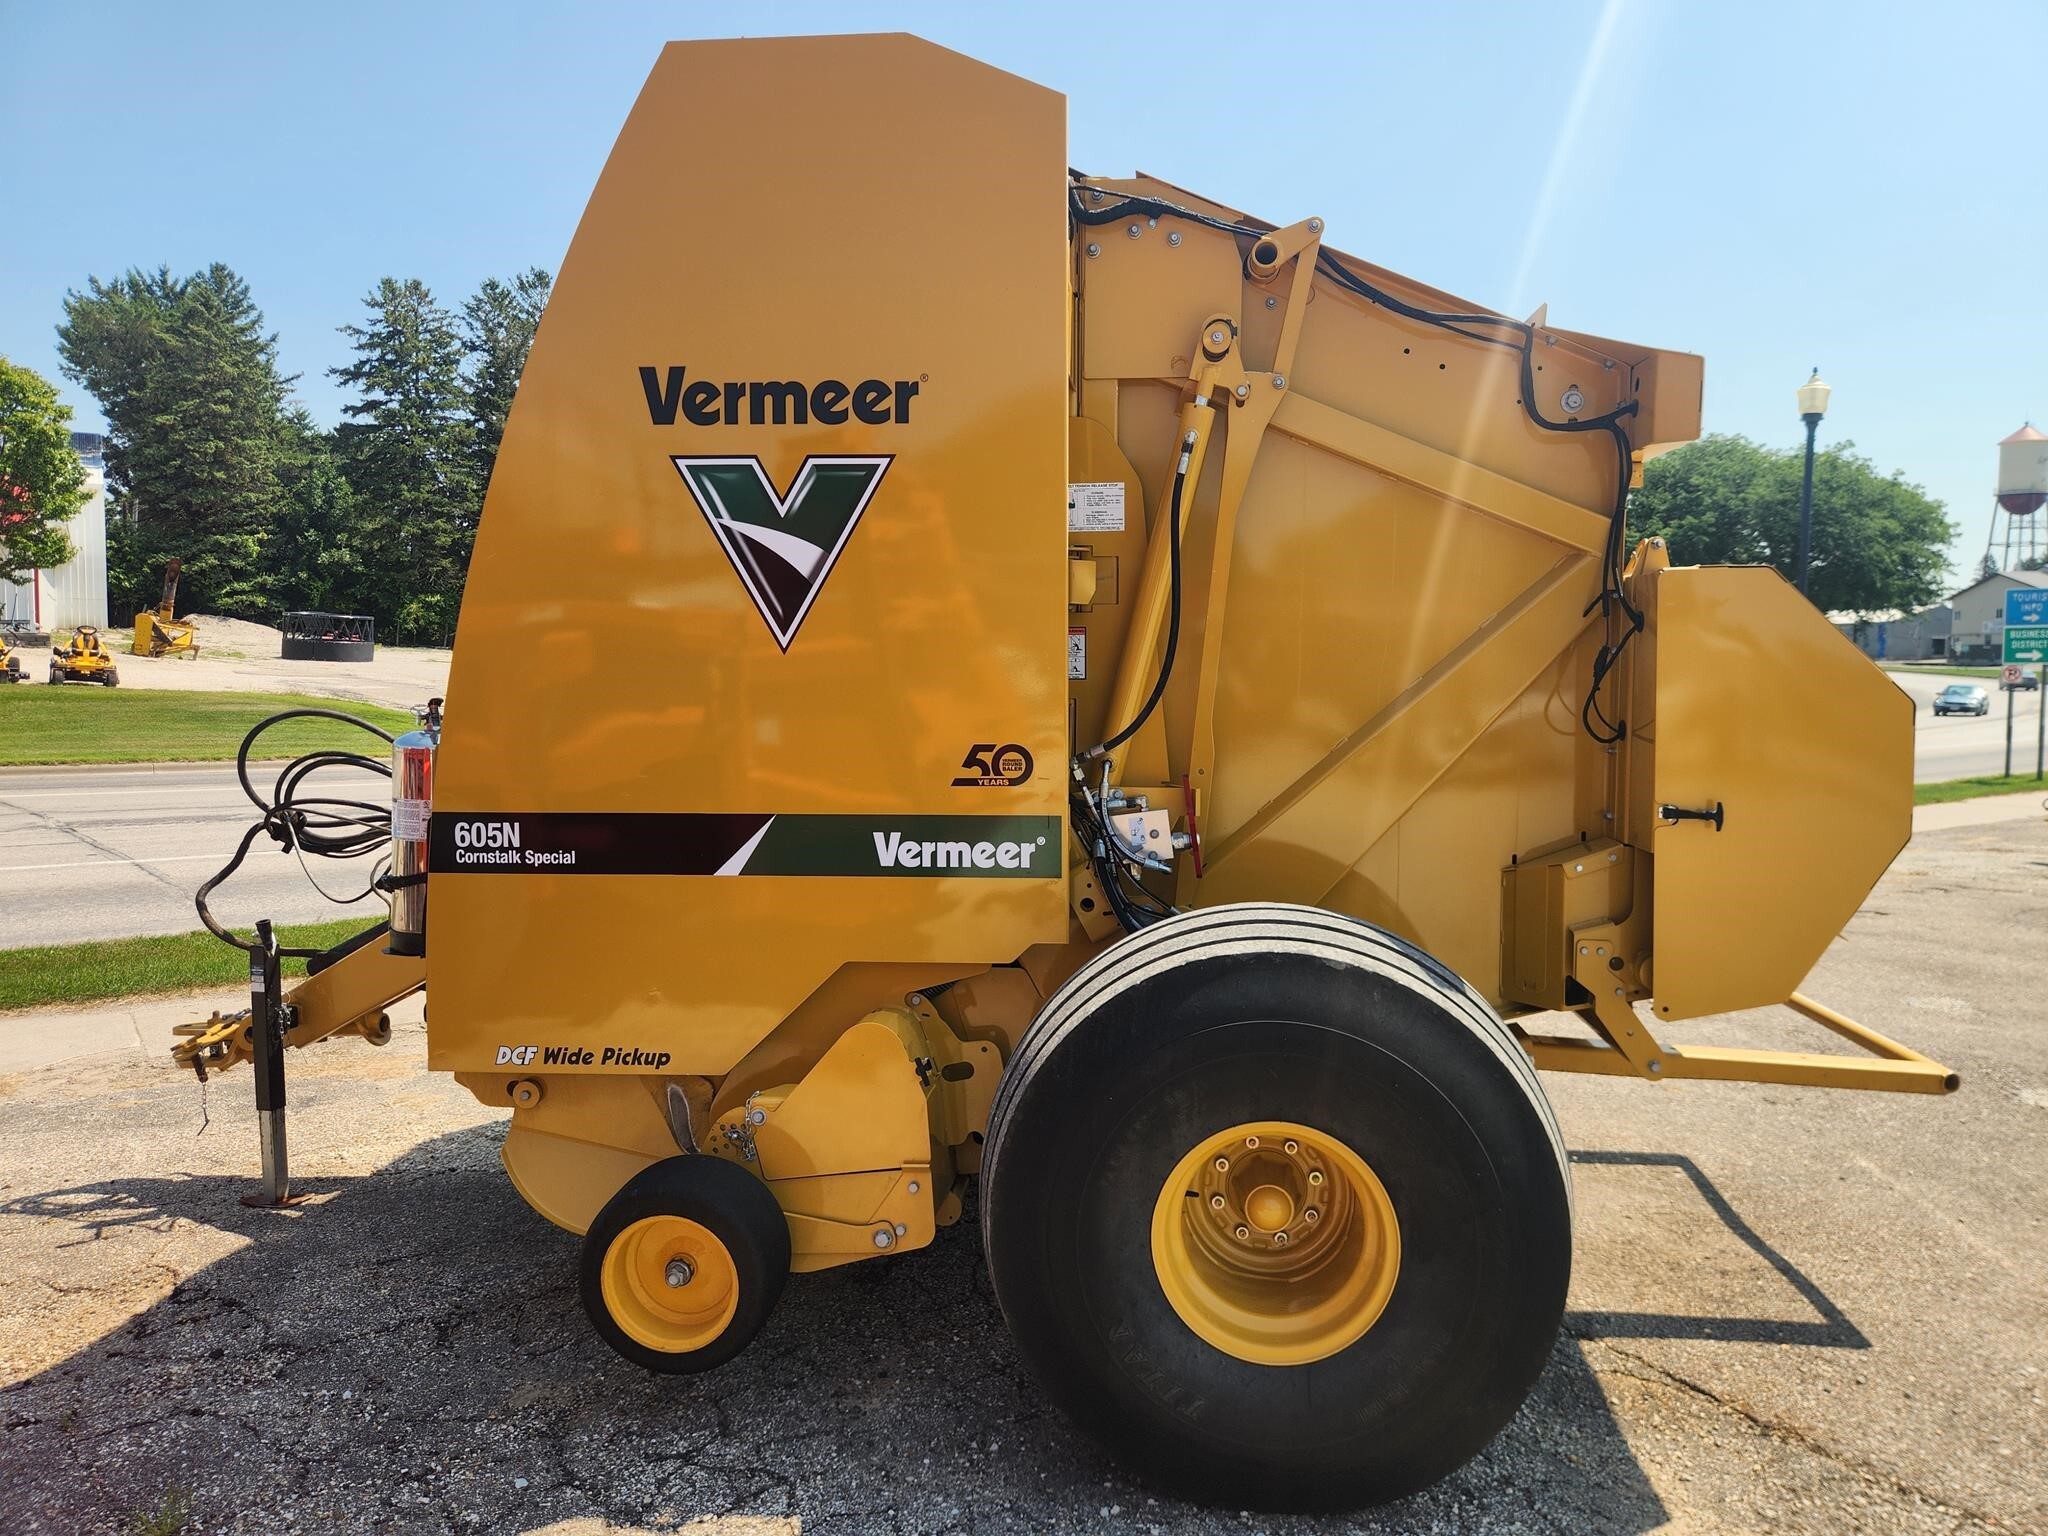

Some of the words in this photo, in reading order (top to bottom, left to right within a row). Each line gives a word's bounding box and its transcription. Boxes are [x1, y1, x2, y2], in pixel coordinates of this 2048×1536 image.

[639, 366, 919, 425] Vermeer
[2013, 592, 2048, 600] TOURIS
[454, 822, 520, 848] 605N
[456, 850, 521, 864] Cornstalk
[525, 850, 576, 867] Special
[873, 832, 1035, 869] Vermeer
[495, 1045, 539, 1066] DCF
[543, 1046, 595, 1065] Wide
[600, 1047, 671, 1070] Pickup
